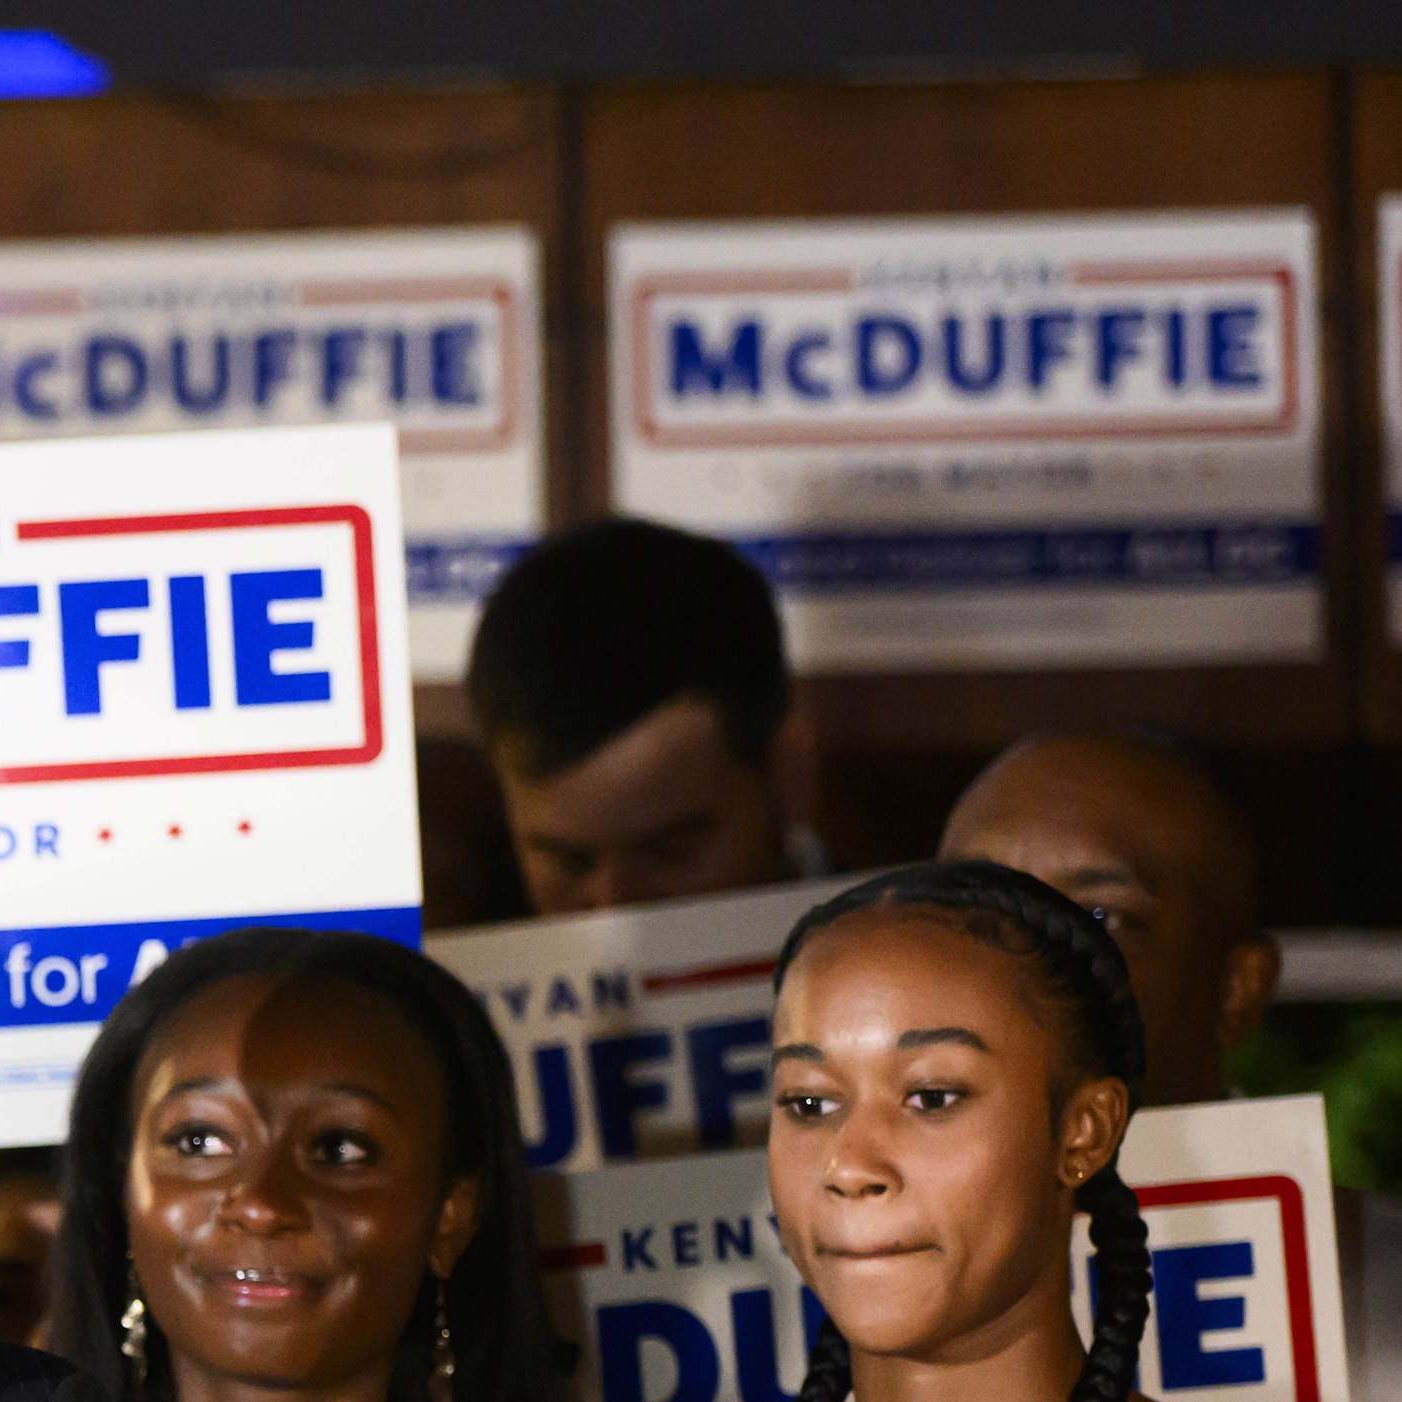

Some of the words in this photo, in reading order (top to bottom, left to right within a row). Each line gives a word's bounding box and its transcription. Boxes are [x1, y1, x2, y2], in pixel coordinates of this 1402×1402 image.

[668, 305, 1263, 400] McDUFFIE
[8, 944, 106, 1006] for
[474, 969, 630, 1021] YAN
